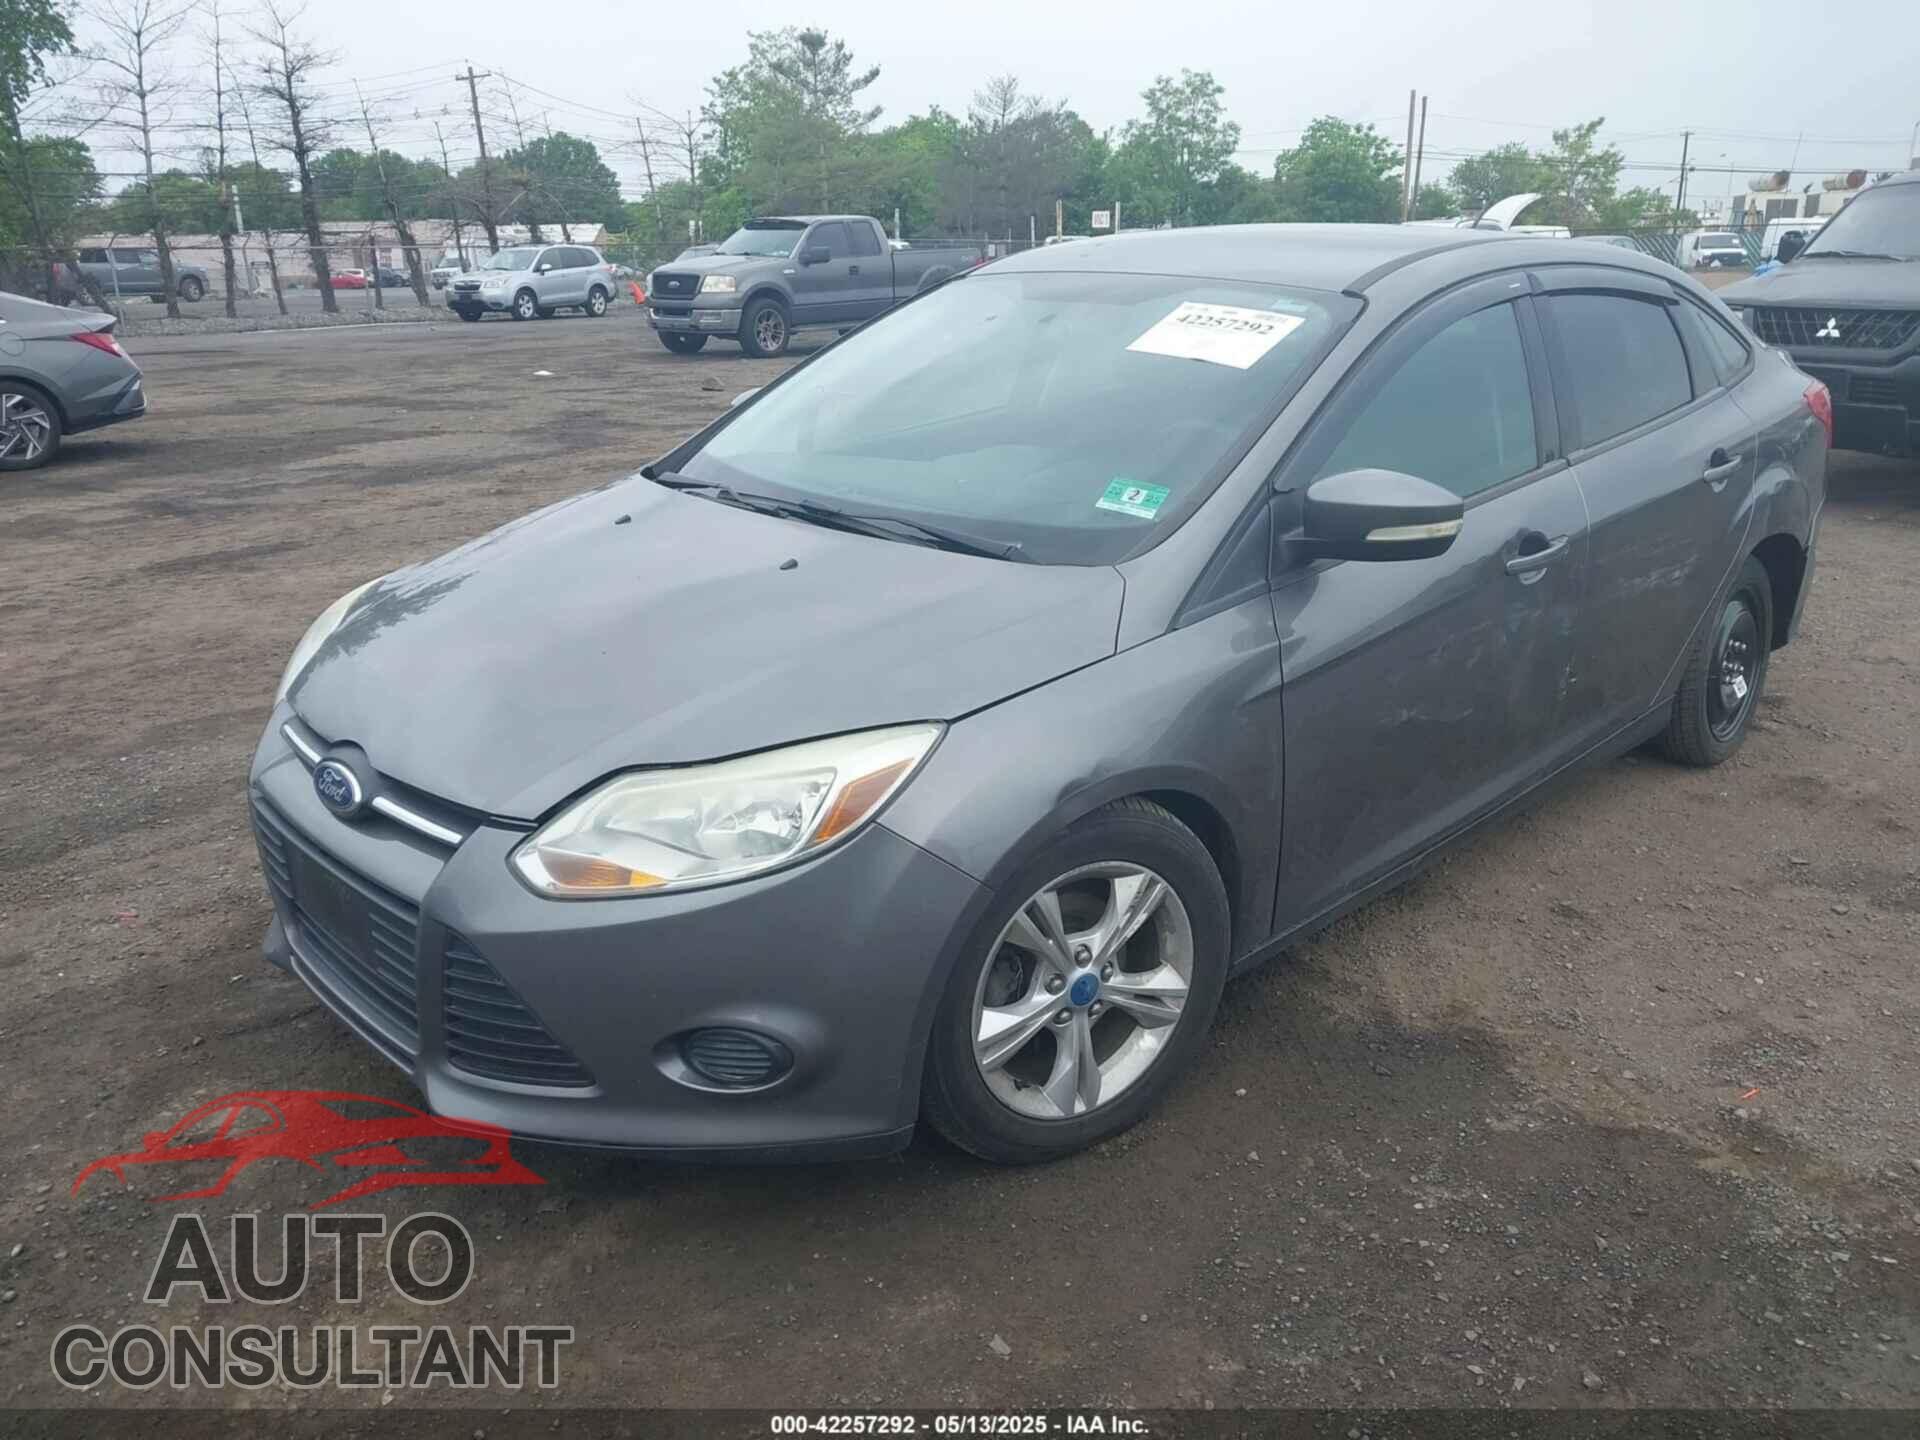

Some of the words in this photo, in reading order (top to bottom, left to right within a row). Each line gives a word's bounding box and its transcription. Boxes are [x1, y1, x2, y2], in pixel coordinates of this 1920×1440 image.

[1176, 313, 1275, 336] 42257292
[1127, 488, 1142, 501] 2
[318, 768, 347, 802] Ford
